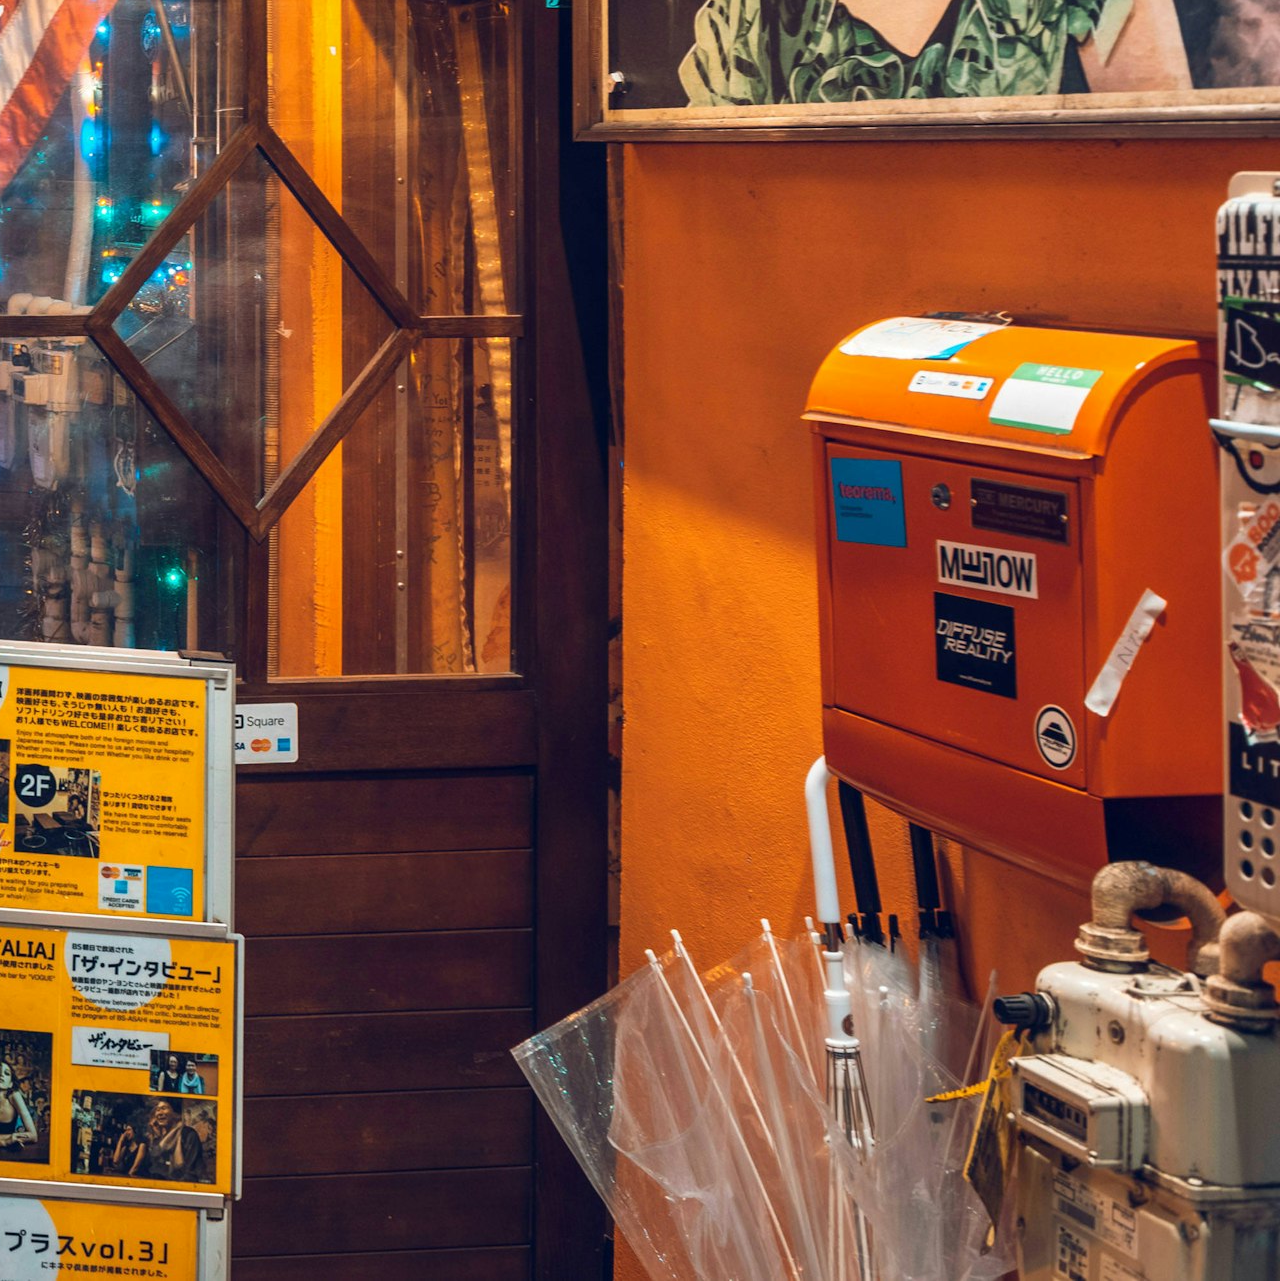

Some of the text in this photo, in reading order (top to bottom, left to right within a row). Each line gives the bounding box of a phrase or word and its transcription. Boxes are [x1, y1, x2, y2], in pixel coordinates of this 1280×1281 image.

[1036, 365, 1085, 381] HELLO
[998, 492, 1059, 517] MERCURY
[936, 619, 1007, 648] DIFFUSE
[944, 639, 1013, 664] REALITY
[247, 716, 285, 728] Square
[20, 774, 52, 797] 2F
